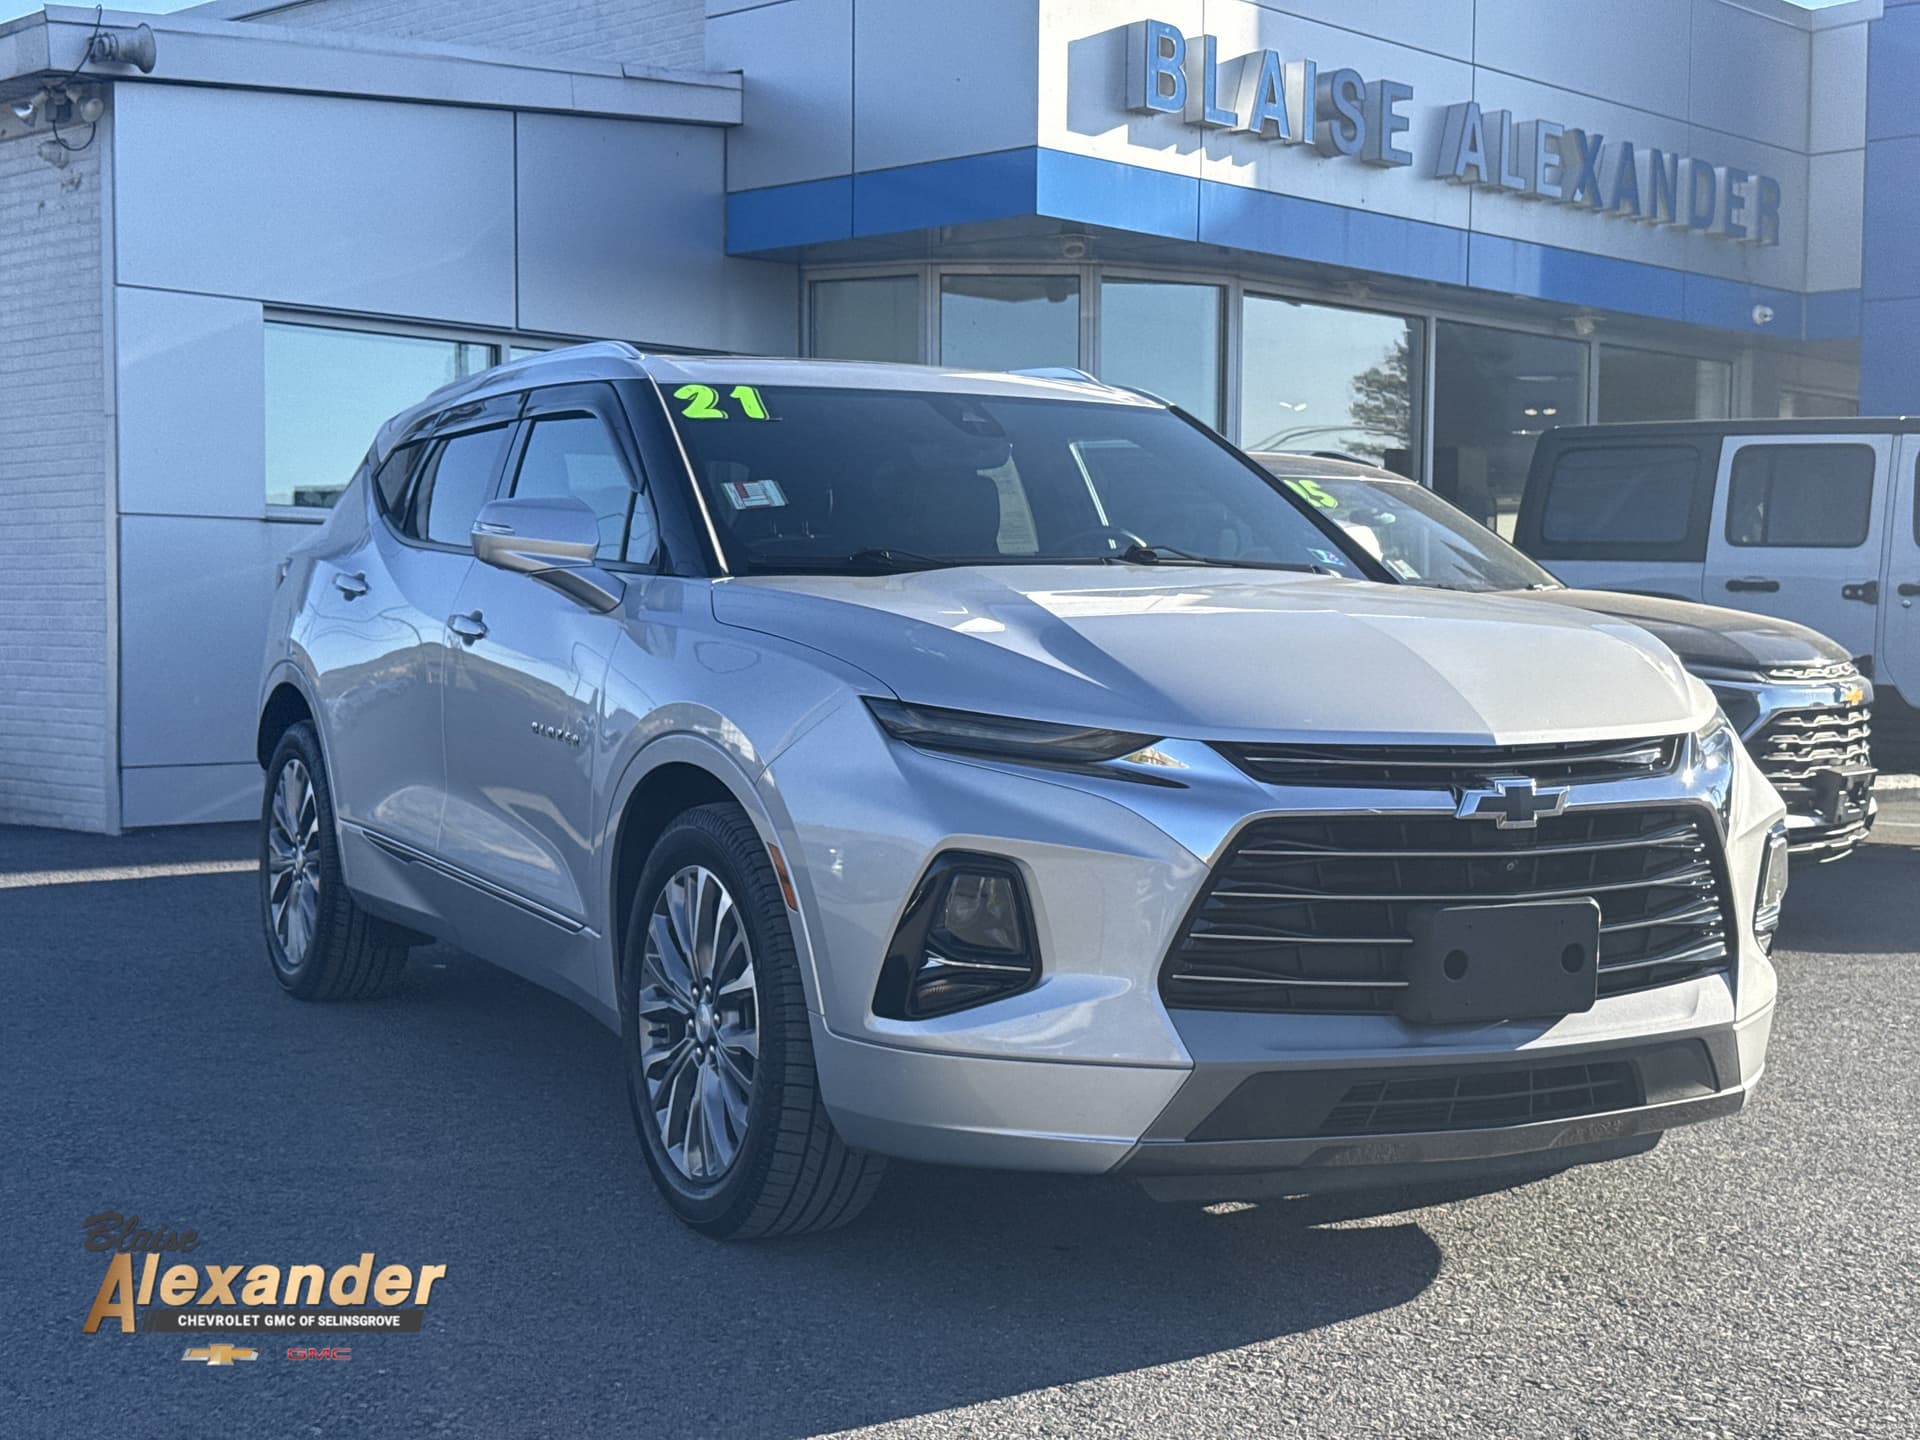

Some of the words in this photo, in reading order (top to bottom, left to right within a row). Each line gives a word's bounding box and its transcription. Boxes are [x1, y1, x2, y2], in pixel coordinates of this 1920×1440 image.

[1127, 18, 1414, 168] BLAISE
[1436, 101, 1782, 246] ALEXANDER
[673, 384, 770, 420] 21
